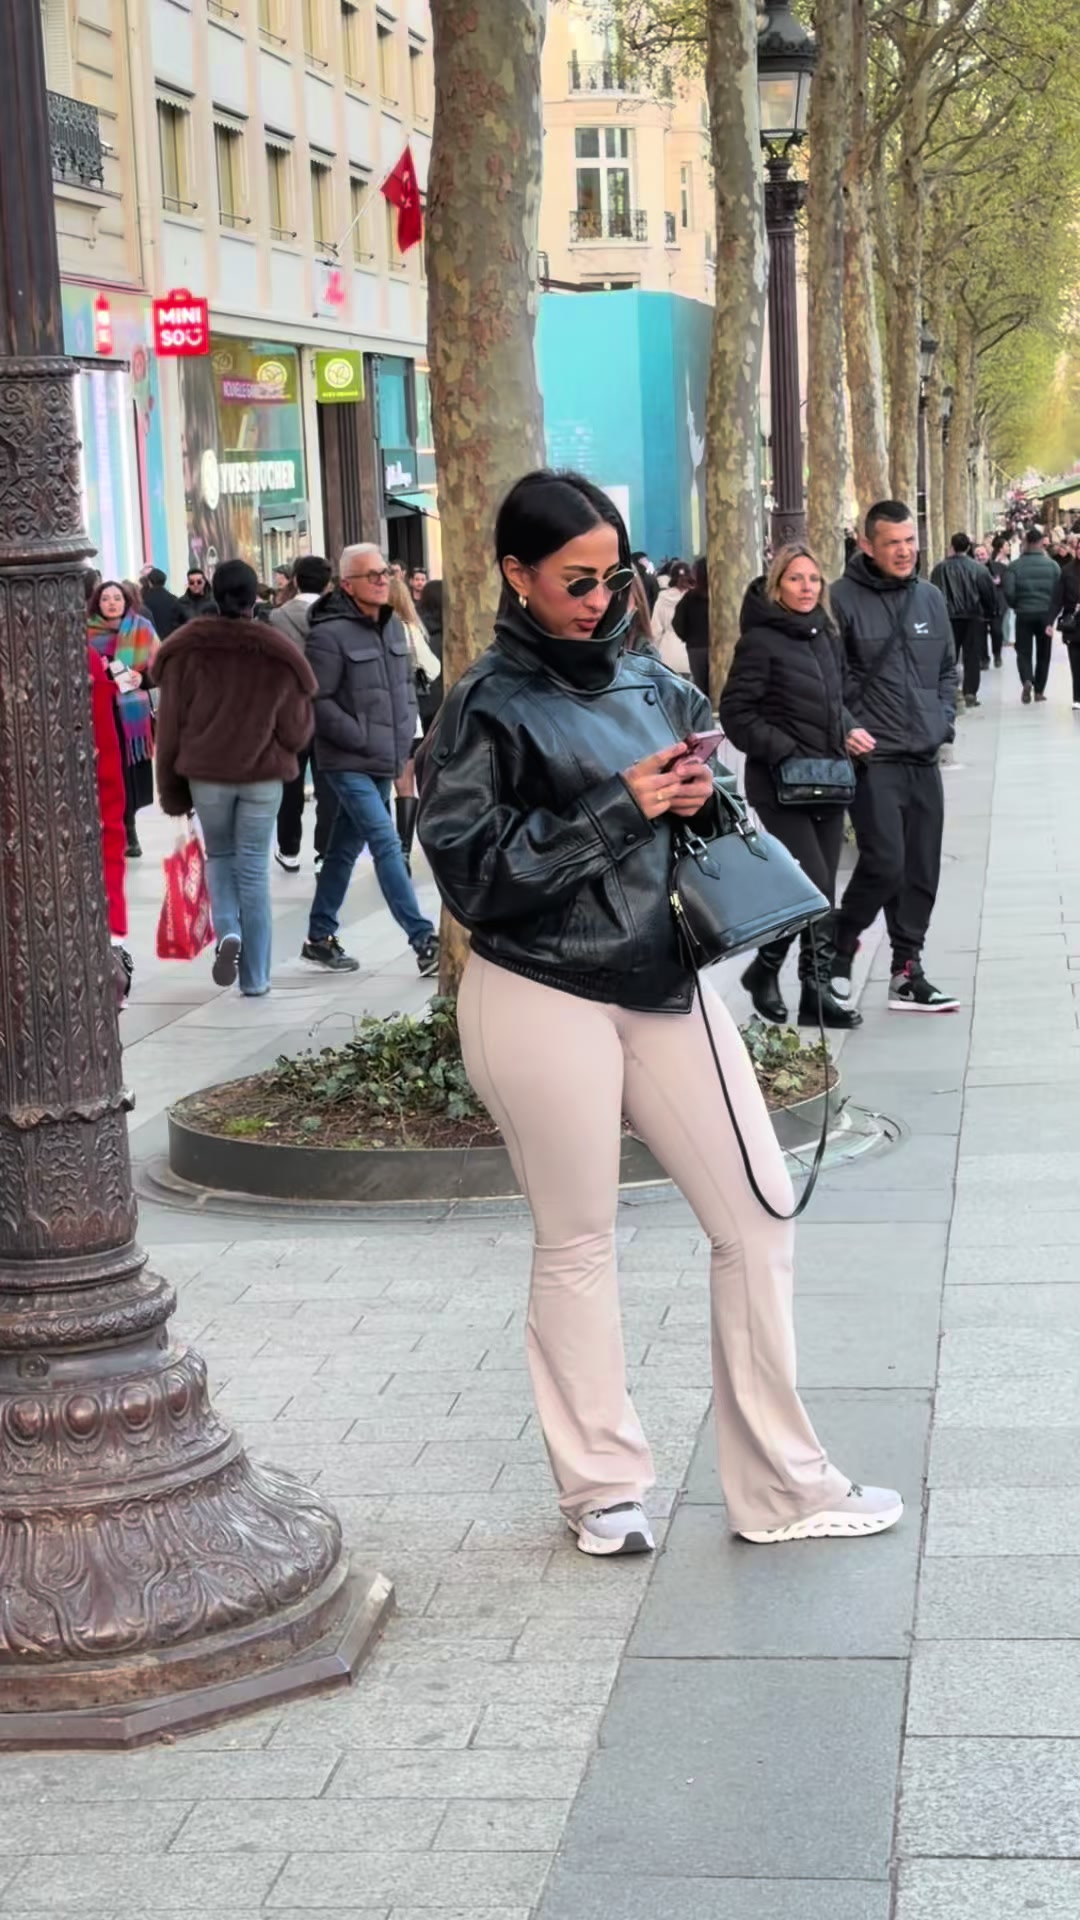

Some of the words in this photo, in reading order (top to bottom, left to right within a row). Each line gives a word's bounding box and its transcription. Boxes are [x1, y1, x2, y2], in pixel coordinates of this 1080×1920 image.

[159, 307, 201, 325] MINI
[220, 461, 250, 494] YVES
[250, 459, 296, 491] ROCHER
